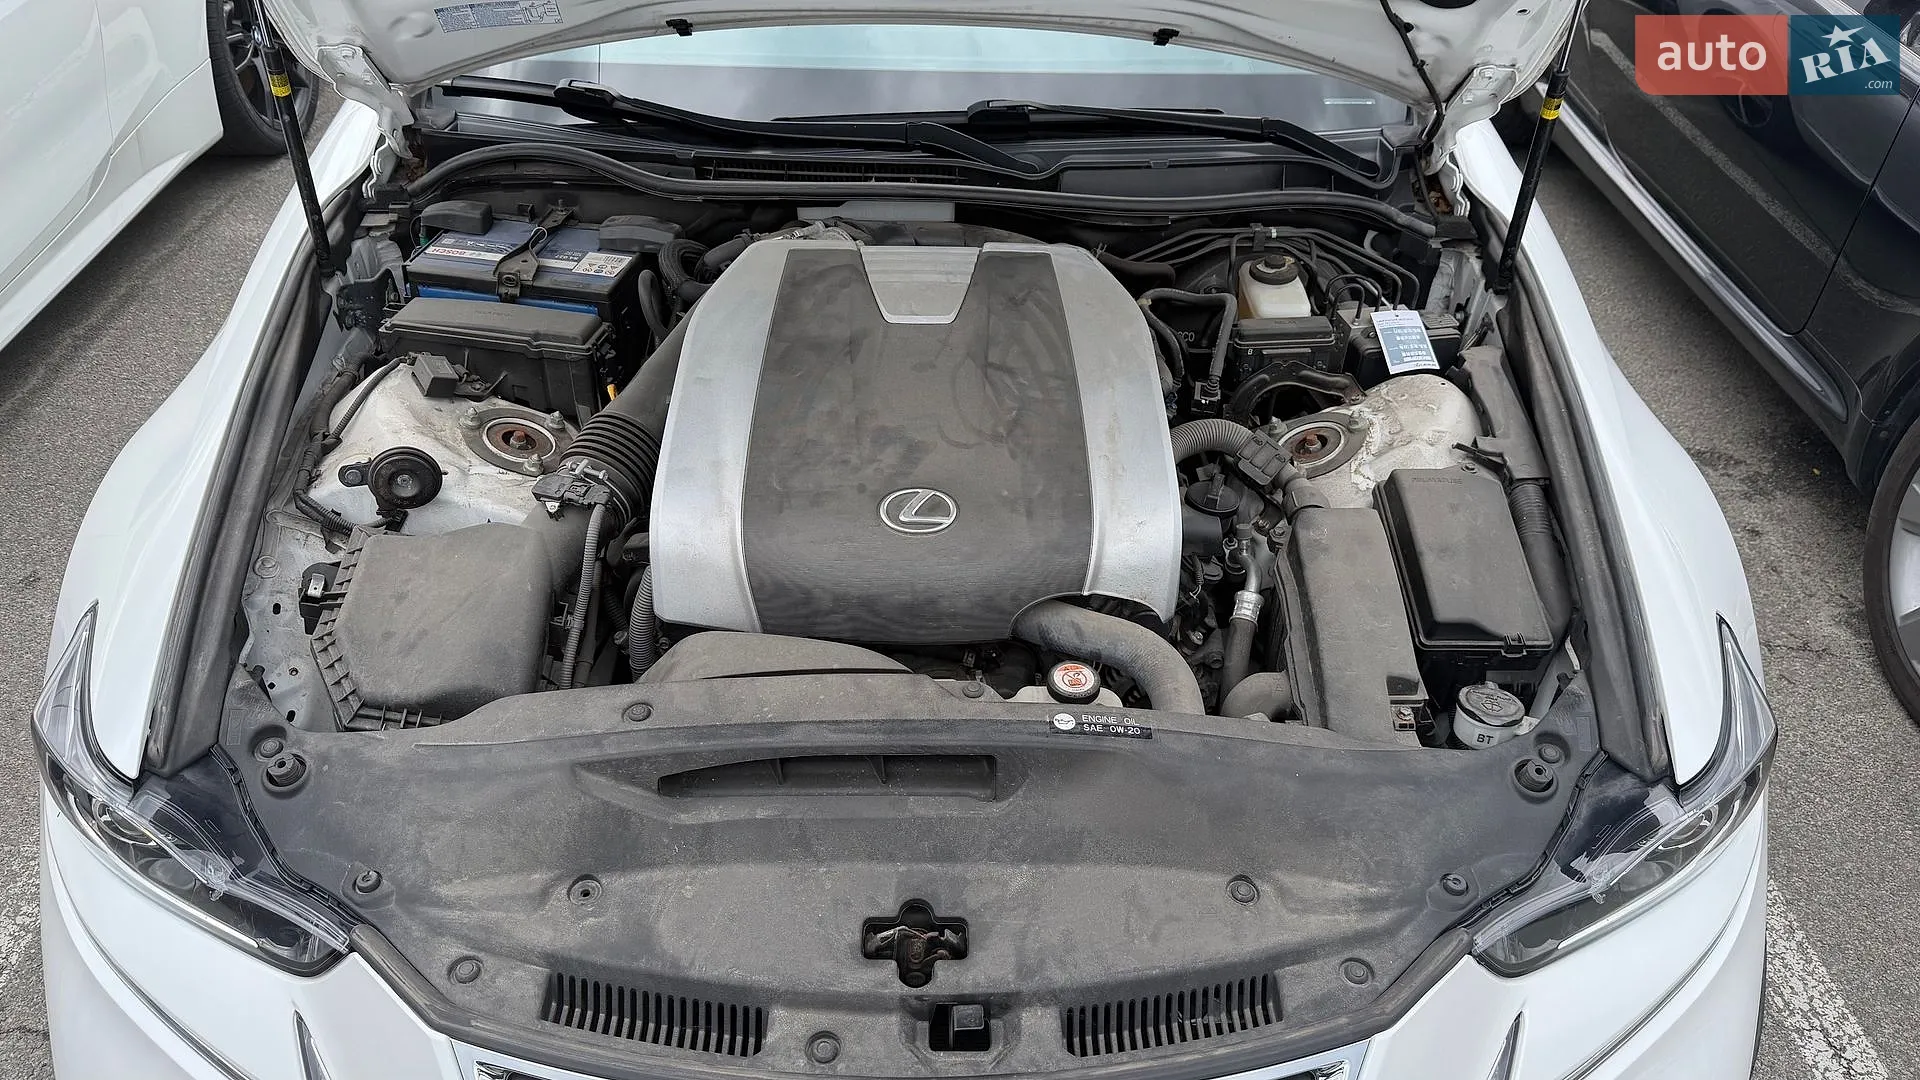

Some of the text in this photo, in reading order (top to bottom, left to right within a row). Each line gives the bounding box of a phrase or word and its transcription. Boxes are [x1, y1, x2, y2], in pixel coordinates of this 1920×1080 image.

[1081, 714, 1141, 726] ENGINE OIL
[1083, 723, 1104, 732] SAE
[1476, 733, 1495, 745] BT
